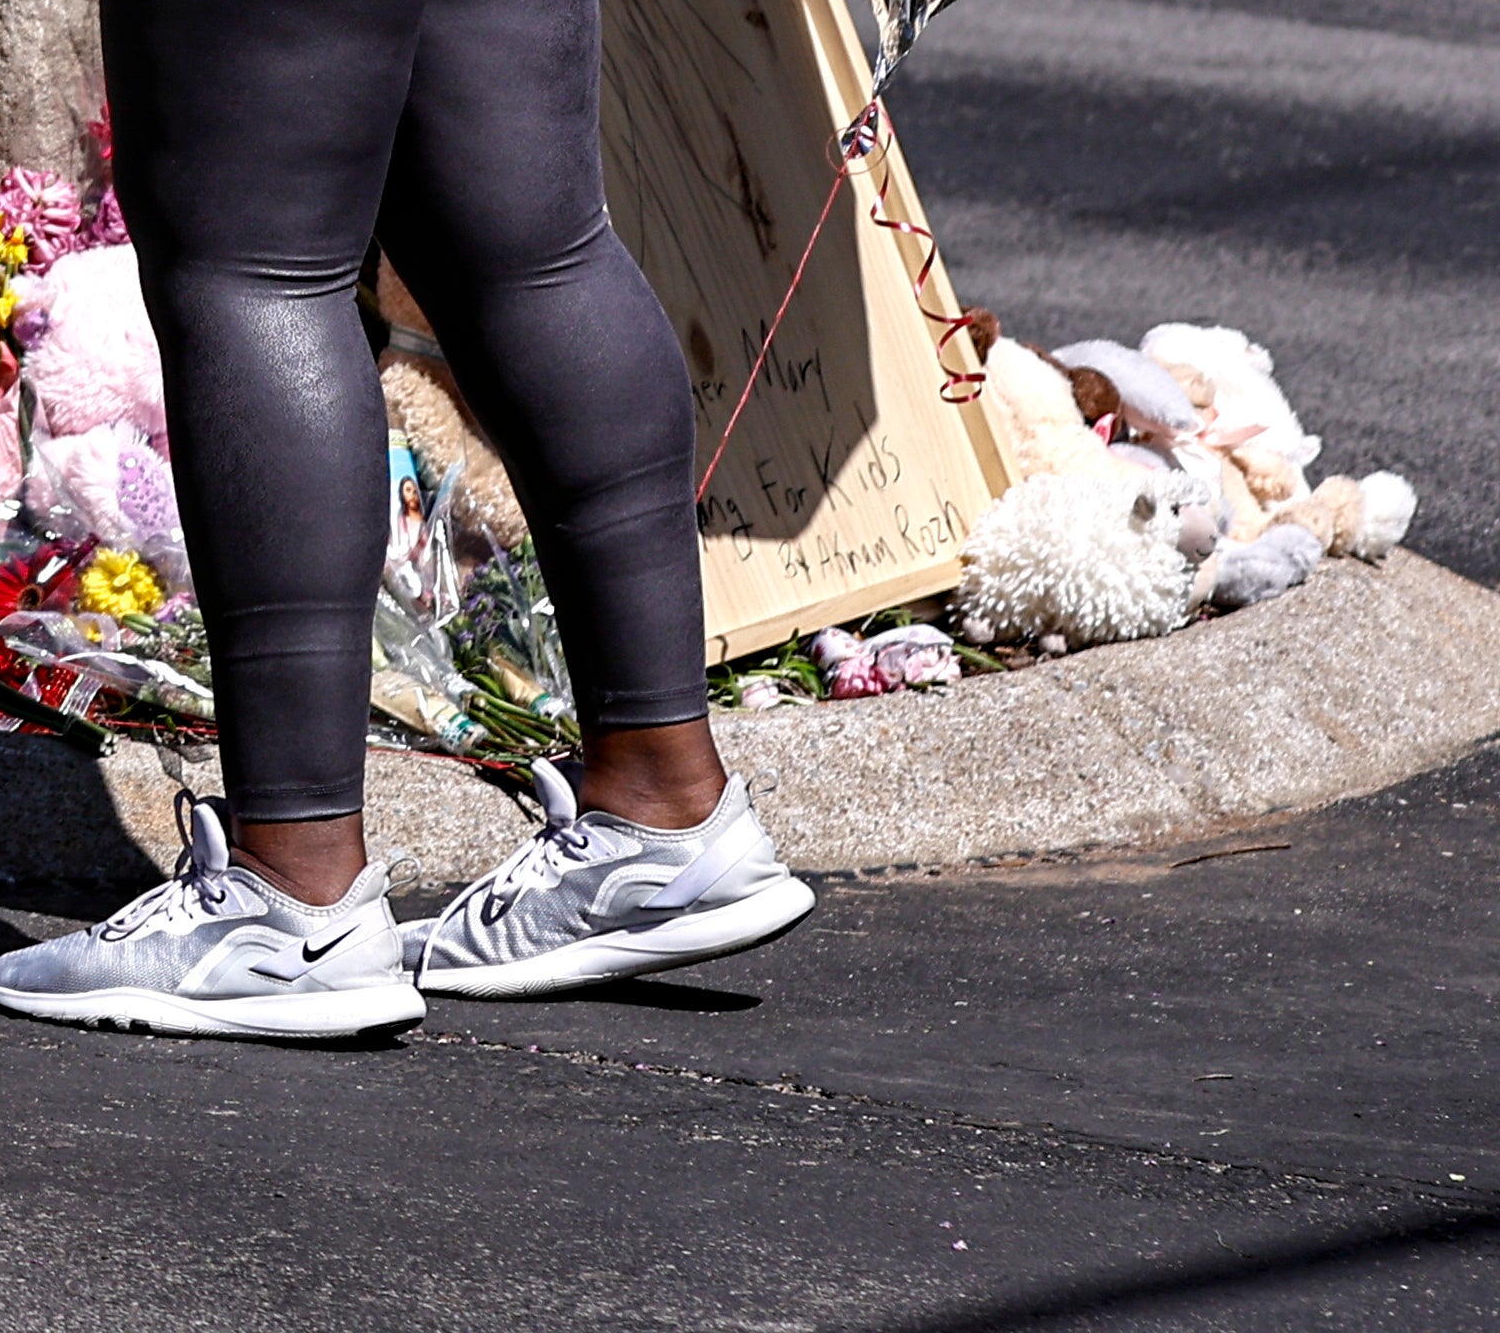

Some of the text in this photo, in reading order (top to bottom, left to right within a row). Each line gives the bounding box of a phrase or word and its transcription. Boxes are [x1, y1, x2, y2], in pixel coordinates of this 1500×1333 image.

[741, 318, 830, 412] Mary
[756, 456, 806, 516] For
[810, 401, 901, 512] Kids
